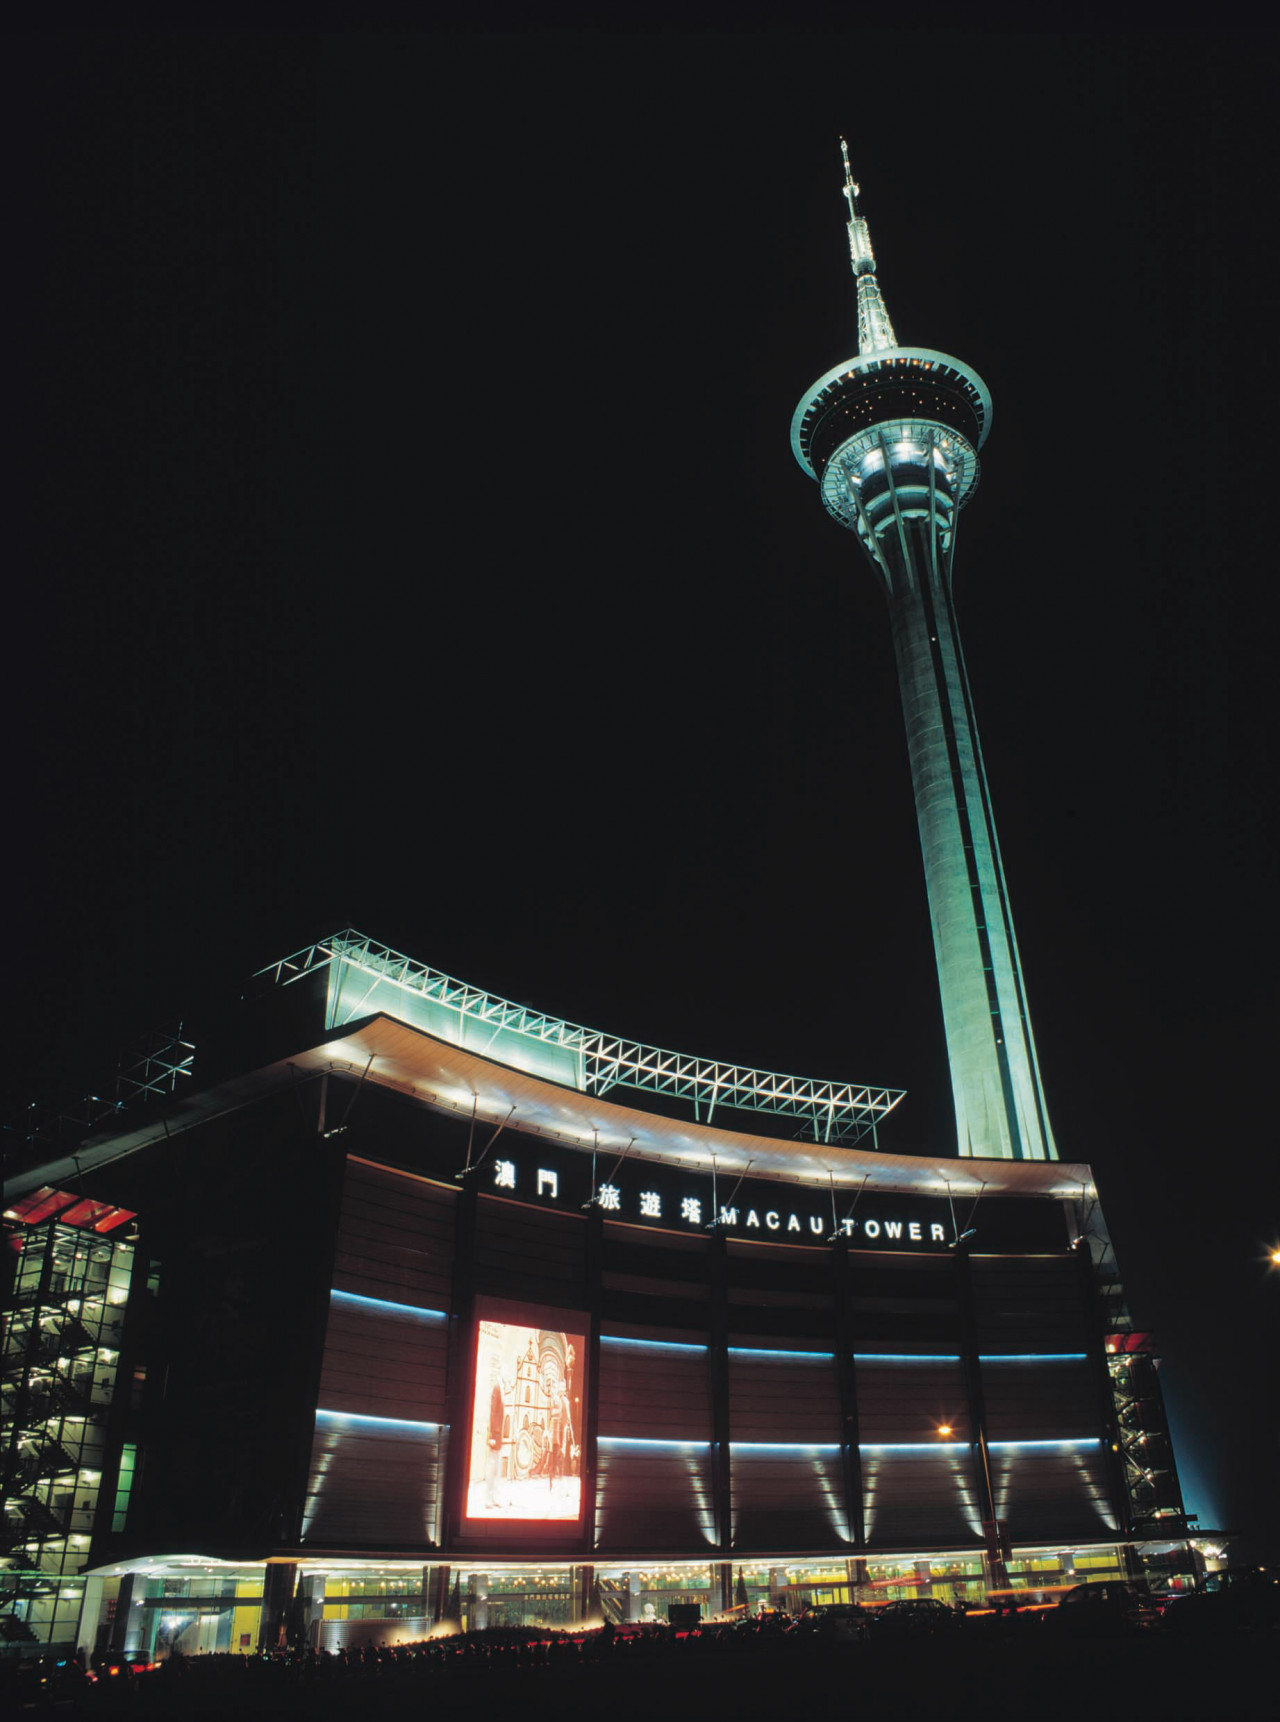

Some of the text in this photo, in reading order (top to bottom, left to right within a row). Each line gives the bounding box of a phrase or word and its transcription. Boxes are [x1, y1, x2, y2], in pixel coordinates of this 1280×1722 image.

[494, 1159, 702, 1224] 澳門旅遊塔
[719, 1205, 945, 1242] MACAU TOWER
